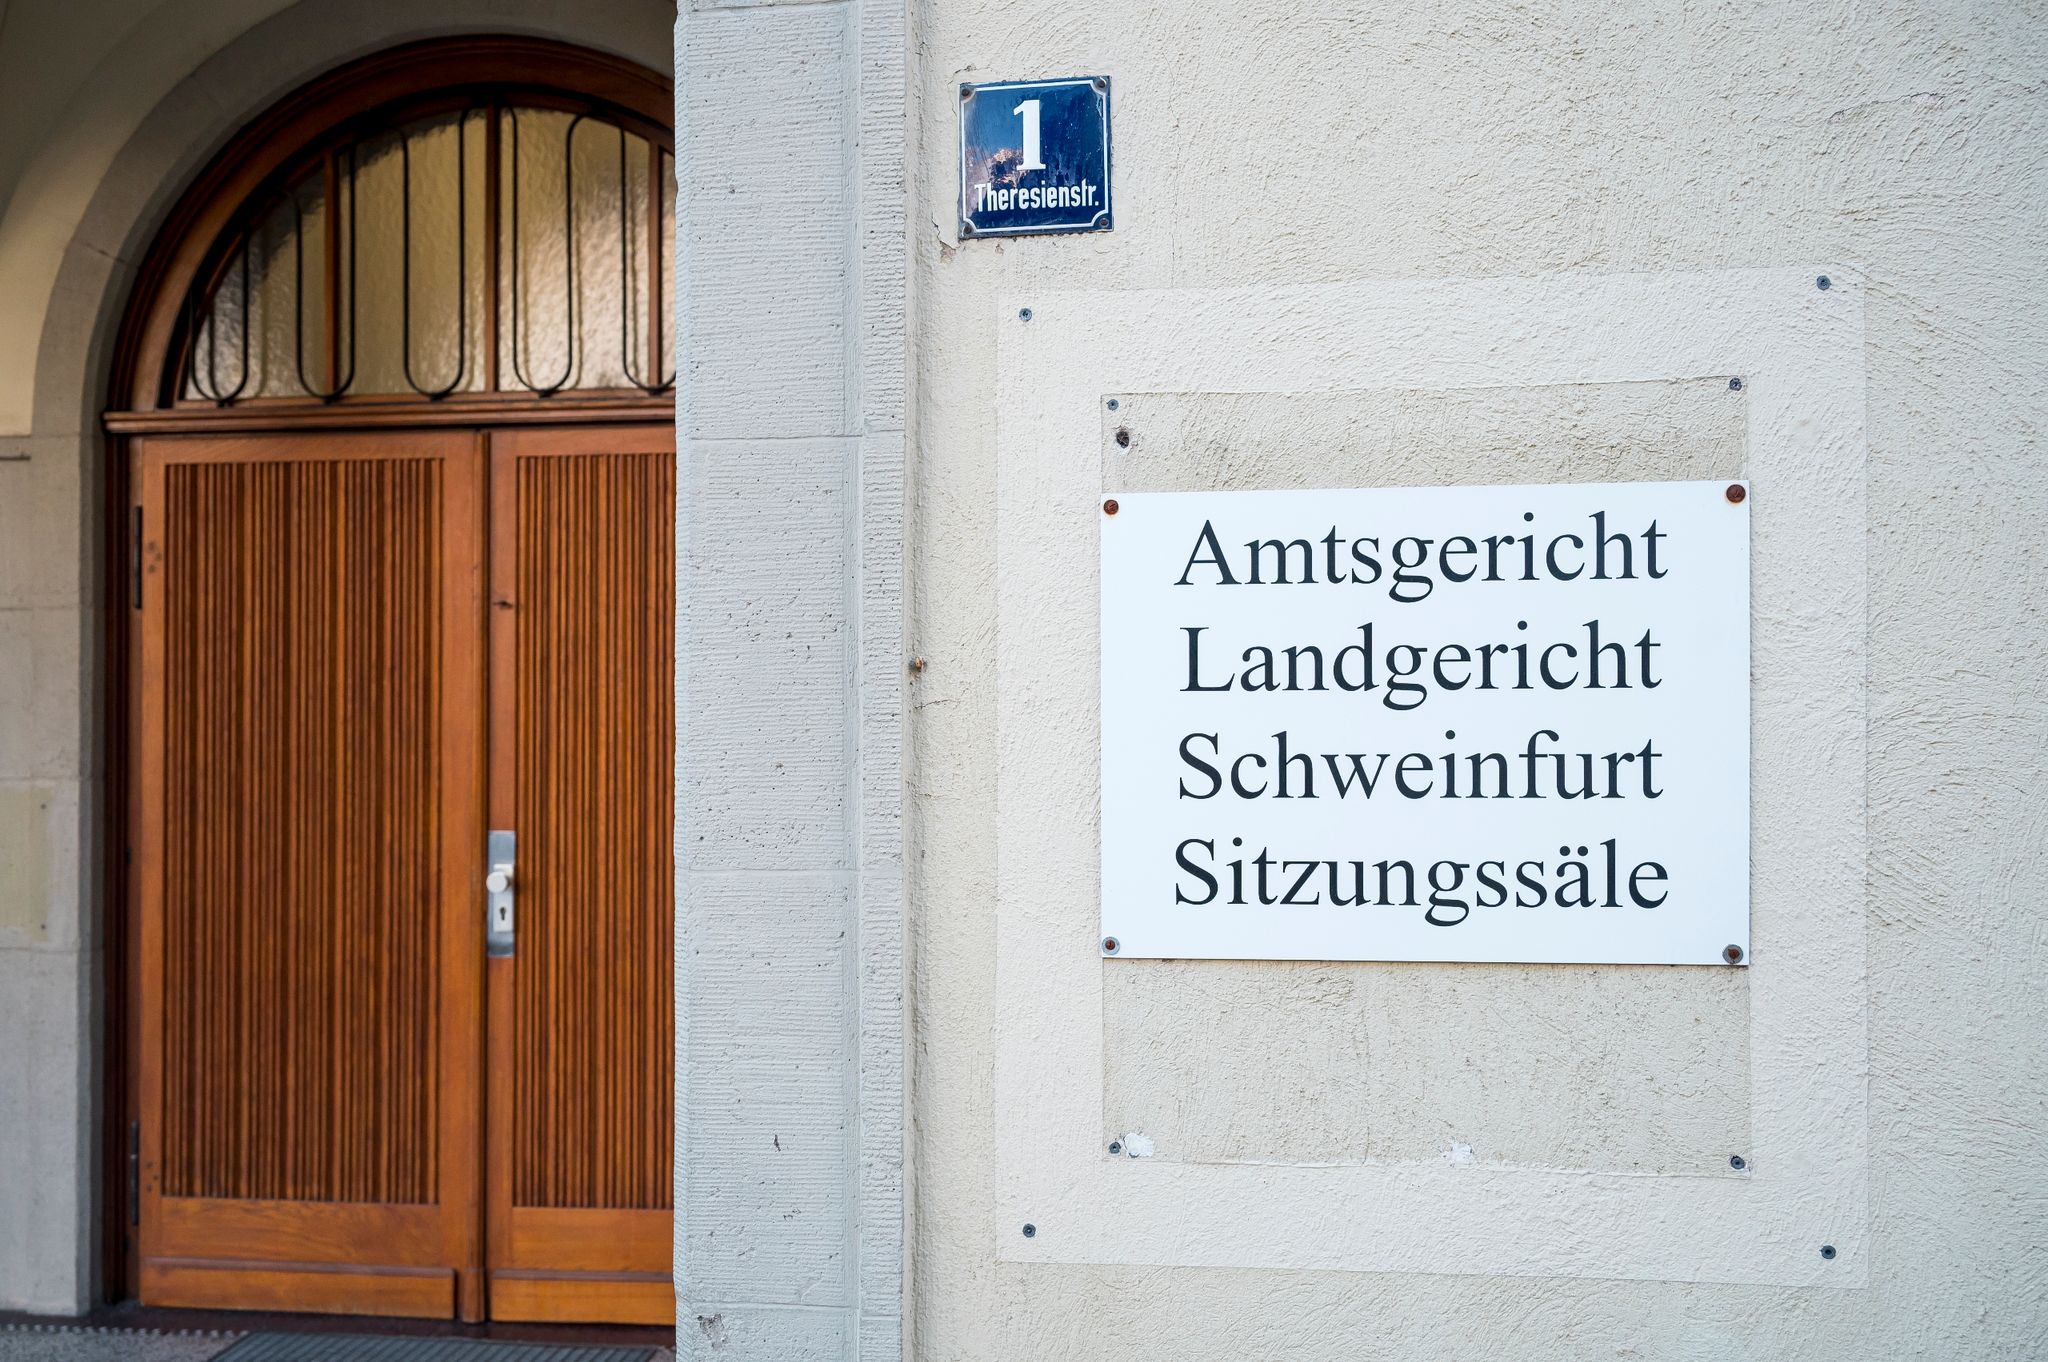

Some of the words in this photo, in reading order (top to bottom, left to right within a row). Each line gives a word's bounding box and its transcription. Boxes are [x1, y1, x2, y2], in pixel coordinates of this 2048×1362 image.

[1013, 99, 1046, 171] 1
[974, 178, 1099, 212] Theresienstr.
[1173, 510, 1669, 604] Amtsgericht
[1179, 619, 1663, 711] Landgericht
[1178, 729, 1664, 800] Schweinfurt
[1175, 836, 1669, 927] Sitzungssäle
